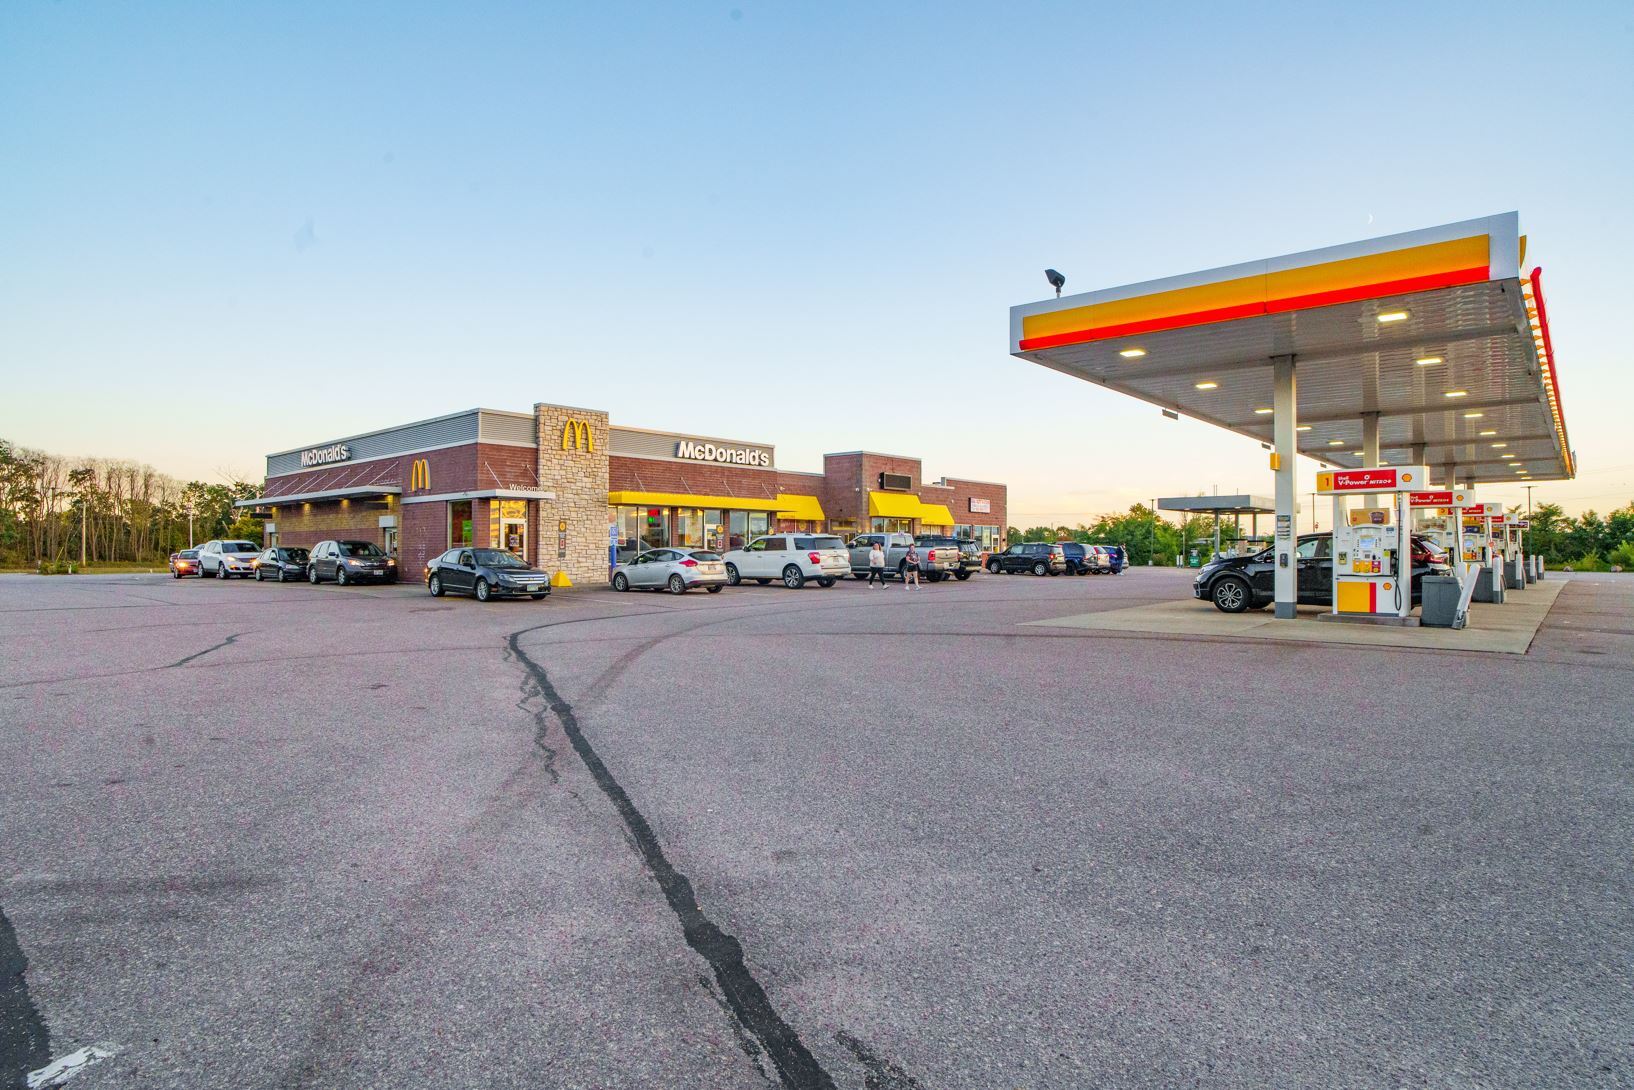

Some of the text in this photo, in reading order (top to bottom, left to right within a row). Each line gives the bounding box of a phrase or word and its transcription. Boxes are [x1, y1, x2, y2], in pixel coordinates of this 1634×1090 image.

[301, 443, 348, 467] McDonald's
[678, 440, 769, 467] McDonald's
[1325, 477, 1329, 487] 1
